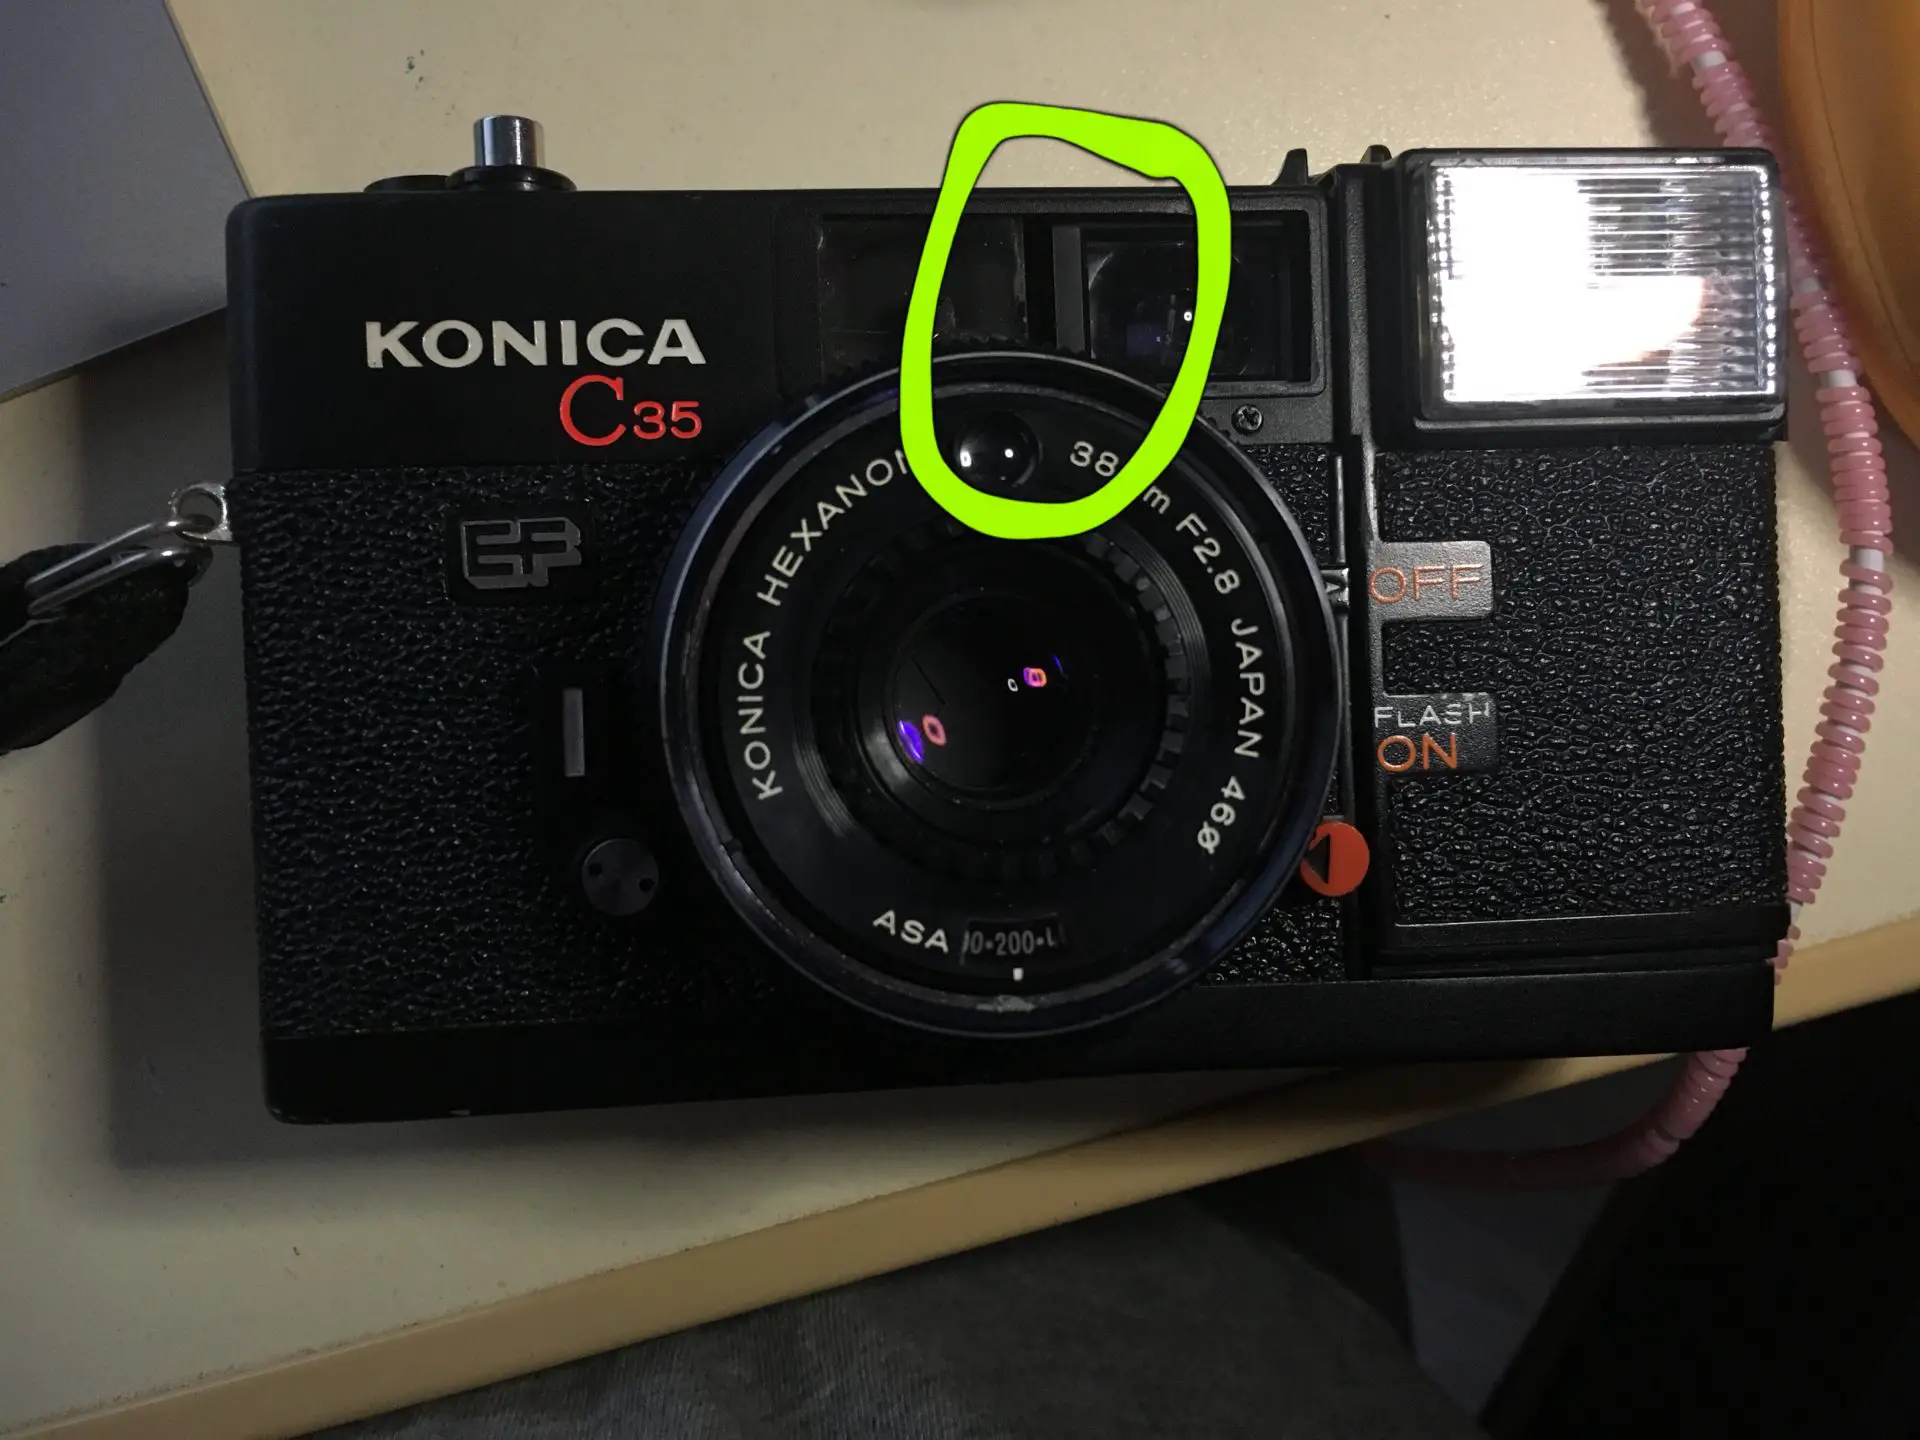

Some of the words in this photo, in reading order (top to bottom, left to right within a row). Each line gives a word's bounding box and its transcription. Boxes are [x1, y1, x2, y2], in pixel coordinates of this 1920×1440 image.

[365, 318, 706, 368] KONICA
[559, 374, 702, 446] C35
[1368, 564, 1484, 604] OFF
[737, 630, 783, 800] KONICA
[1069, 440, 1171, 515] 38m
[1175, 513, 1240, 595] F2.8
[1231, 618, 1265, 758] JAPAN
[1374, 701, 1490, 728] FLASH
[1377, 732, 1458, 772] ON
[872, 909, 949, 953] ASA
